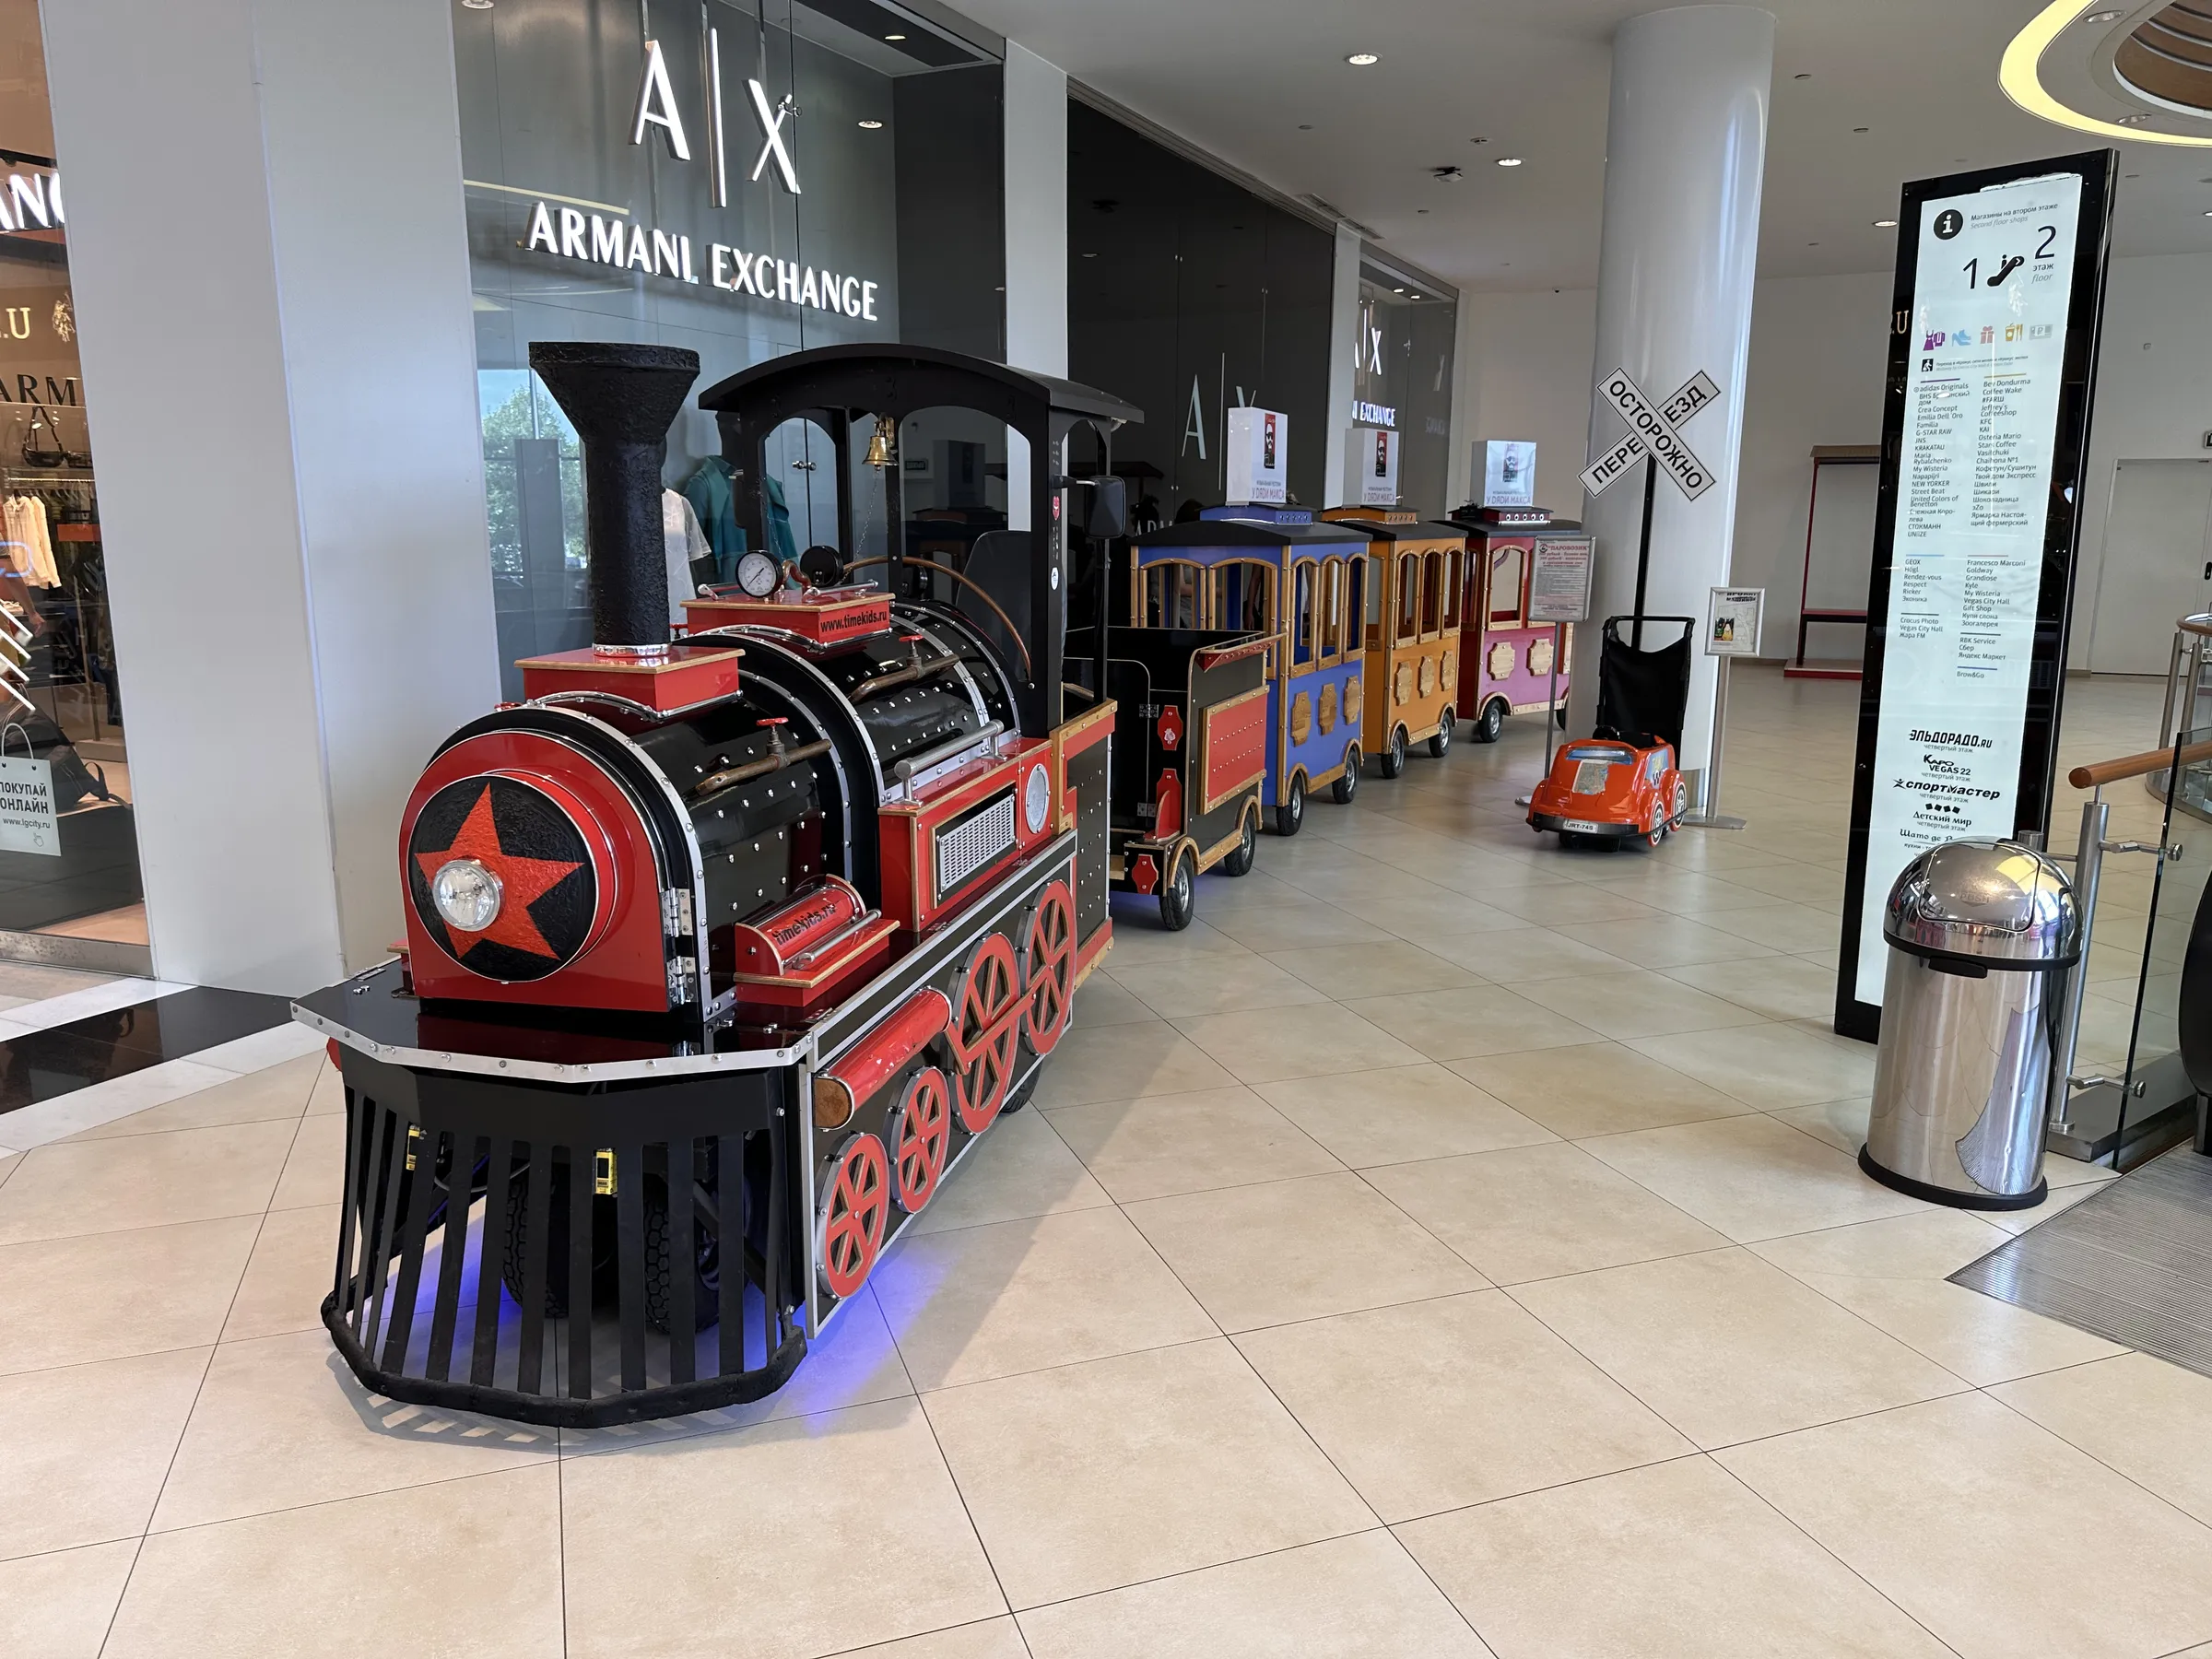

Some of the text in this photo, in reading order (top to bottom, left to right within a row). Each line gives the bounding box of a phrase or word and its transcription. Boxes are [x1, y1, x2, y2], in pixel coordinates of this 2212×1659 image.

[1971, 213, 2003, 221] Магазины
[1971, 216, 2029, 229] Second floor shops
[2034, 225, 2056, 259] 2
[527, 201, 877, 322] ARMANI EXCHANGE
[2032, 263, 2053, 272] этаж
[1962, 258, 1978, 289] 1
[2031, 273, 2053, 284] floor
[1360, 402, 1395, 427] EXCHANGE
[1609, 380, 1702, 488] ОСТОРОЖНО
[1966, 567, 1993, 575] Goldway
[1976, 605, 1992, 613] Shop
[820, 609, 888, 633] www.timekids.ru
[1918, 625, 1930, 633] City
[1929, 764, 1971, 776] VEGAS 22
[1, 797, 49, 814] ОНЛАЙН
[3, 818, 51, 830] www.lgcity.ru
[1913, 811, 1971, 828] Детский мир
[1917, 820, 1949, 829] четвертый
[1900, 829, 1929, 840] Шато
[772, 903, 836, 946] timekids.ru
